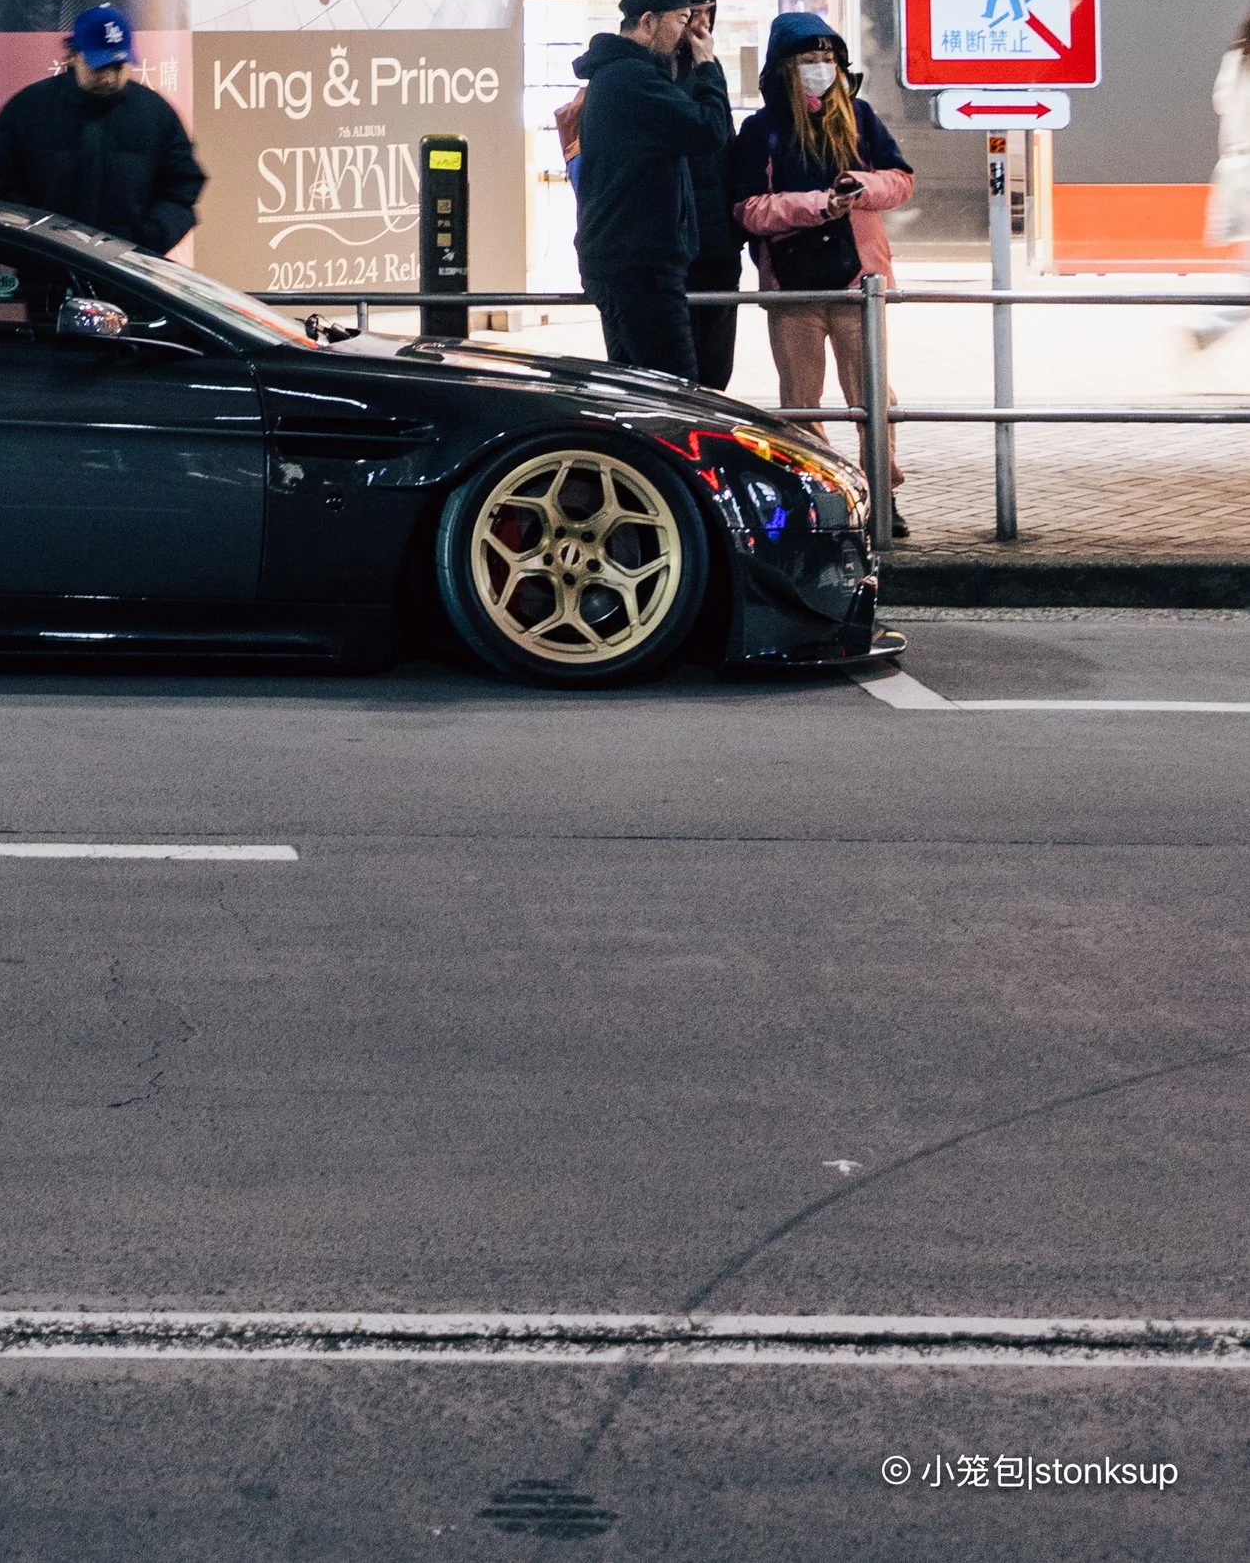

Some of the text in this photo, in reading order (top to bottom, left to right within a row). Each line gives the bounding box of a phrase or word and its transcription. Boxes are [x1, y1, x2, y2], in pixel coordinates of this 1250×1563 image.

[942, 28, 1032, 54] 横断禁止
[214, 55, 500, 120] King & Prince
[338, 124, 386, 138] 7th ALBUM
[257, 143, 421, 217] STARRIN
[267, 259, 379, 292] 2025.12.24
